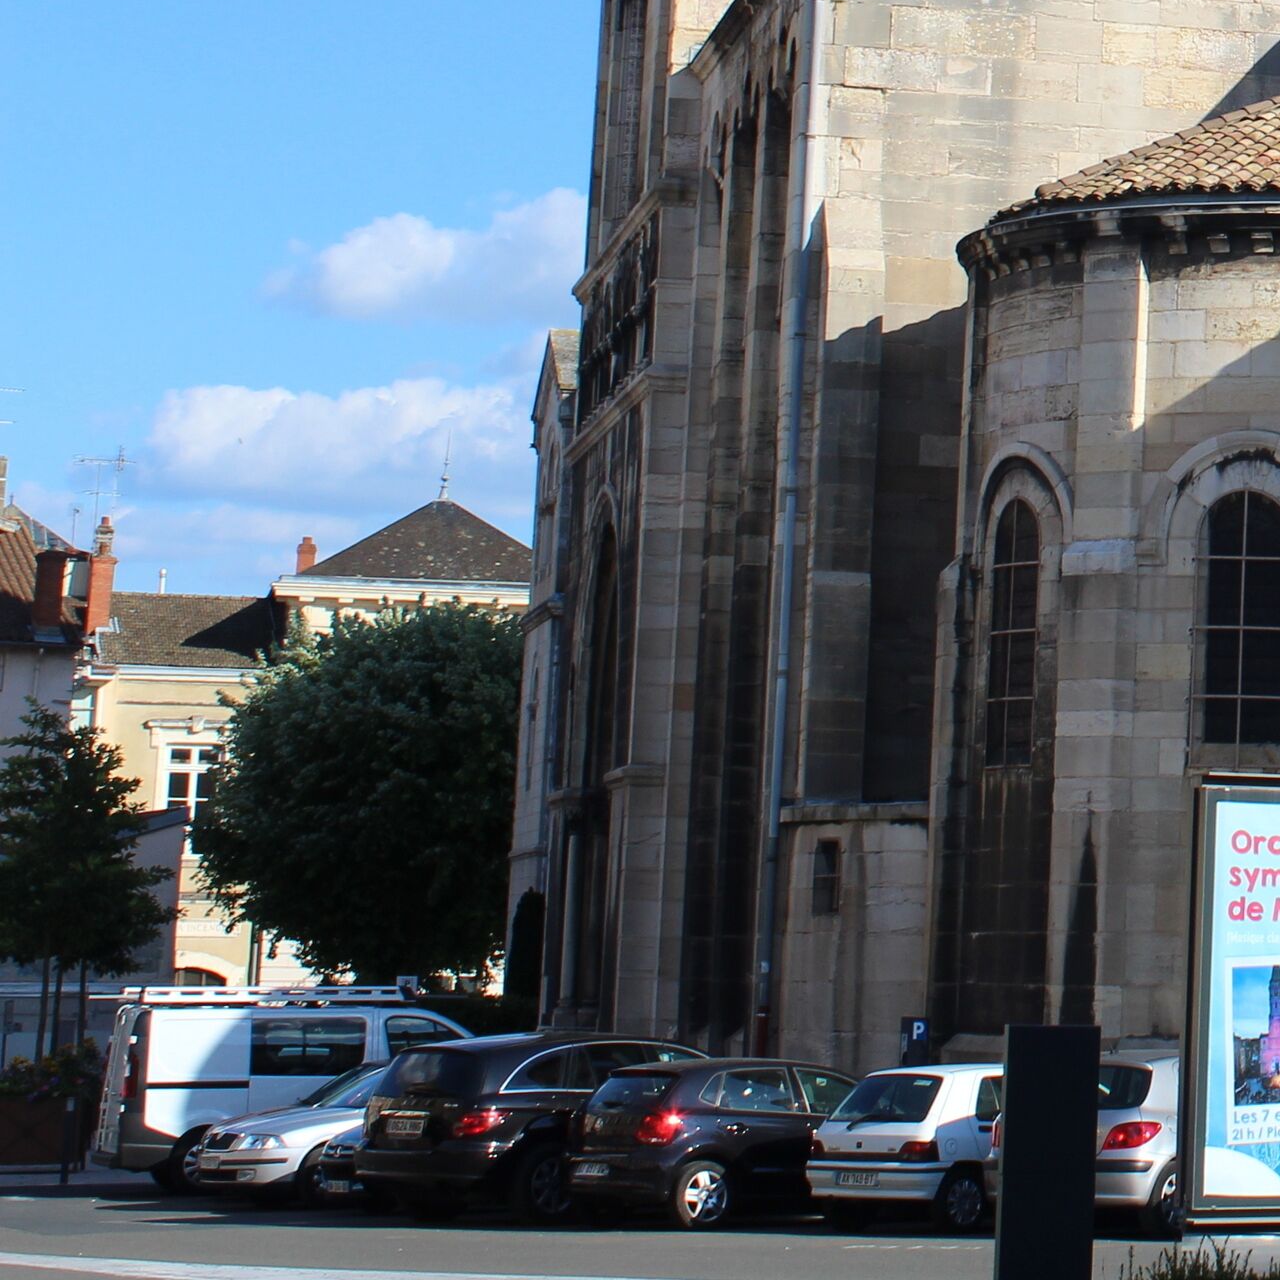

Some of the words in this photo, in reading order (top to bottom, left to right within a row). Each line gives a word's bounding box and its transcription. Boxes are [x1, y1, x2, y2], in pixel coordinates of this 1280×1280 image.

[1227, 896, 1264, 922] de
[912, 1021, 925, 1040] P
[1233, 1110, 1257, 1125] Les
[1261, 1109, 1270, 1122] 7
[1232, 1128, 1243, 1141] 21
[1246, 1127, 1255, 1140] h
